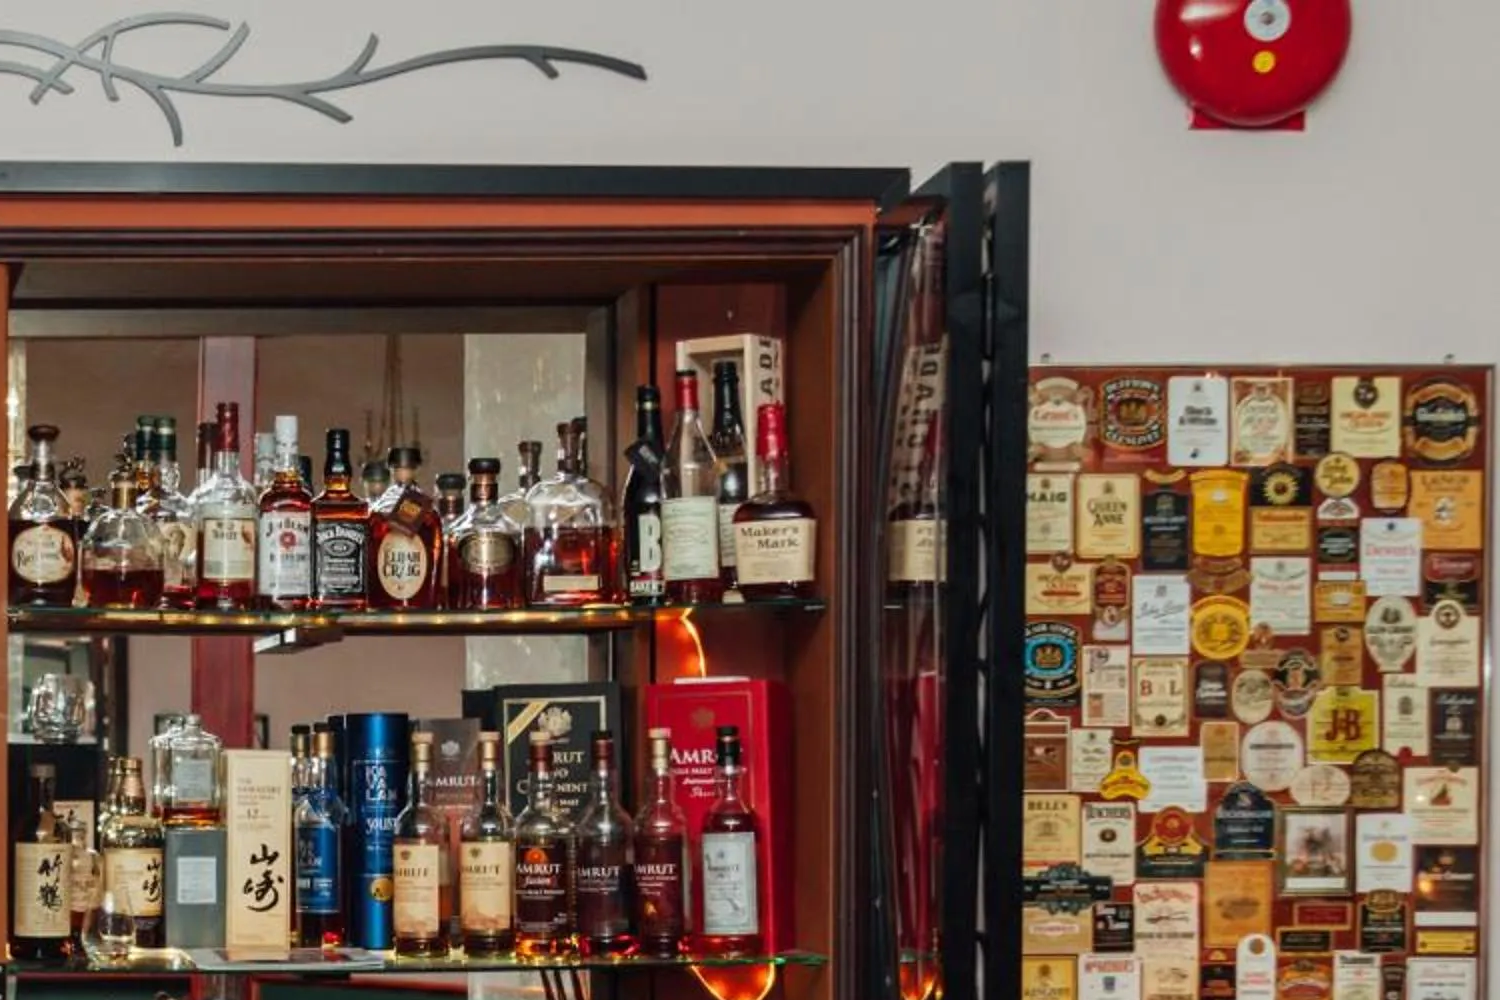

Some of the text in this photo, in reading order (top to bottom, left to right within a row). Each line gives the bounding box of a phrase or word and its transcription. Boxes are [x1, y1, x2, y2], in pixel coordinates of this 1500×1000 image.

[740, 526, 800, 538] Maker's
[638, 514, 663, 572] B
[552, 751, 586, 764] RUT
